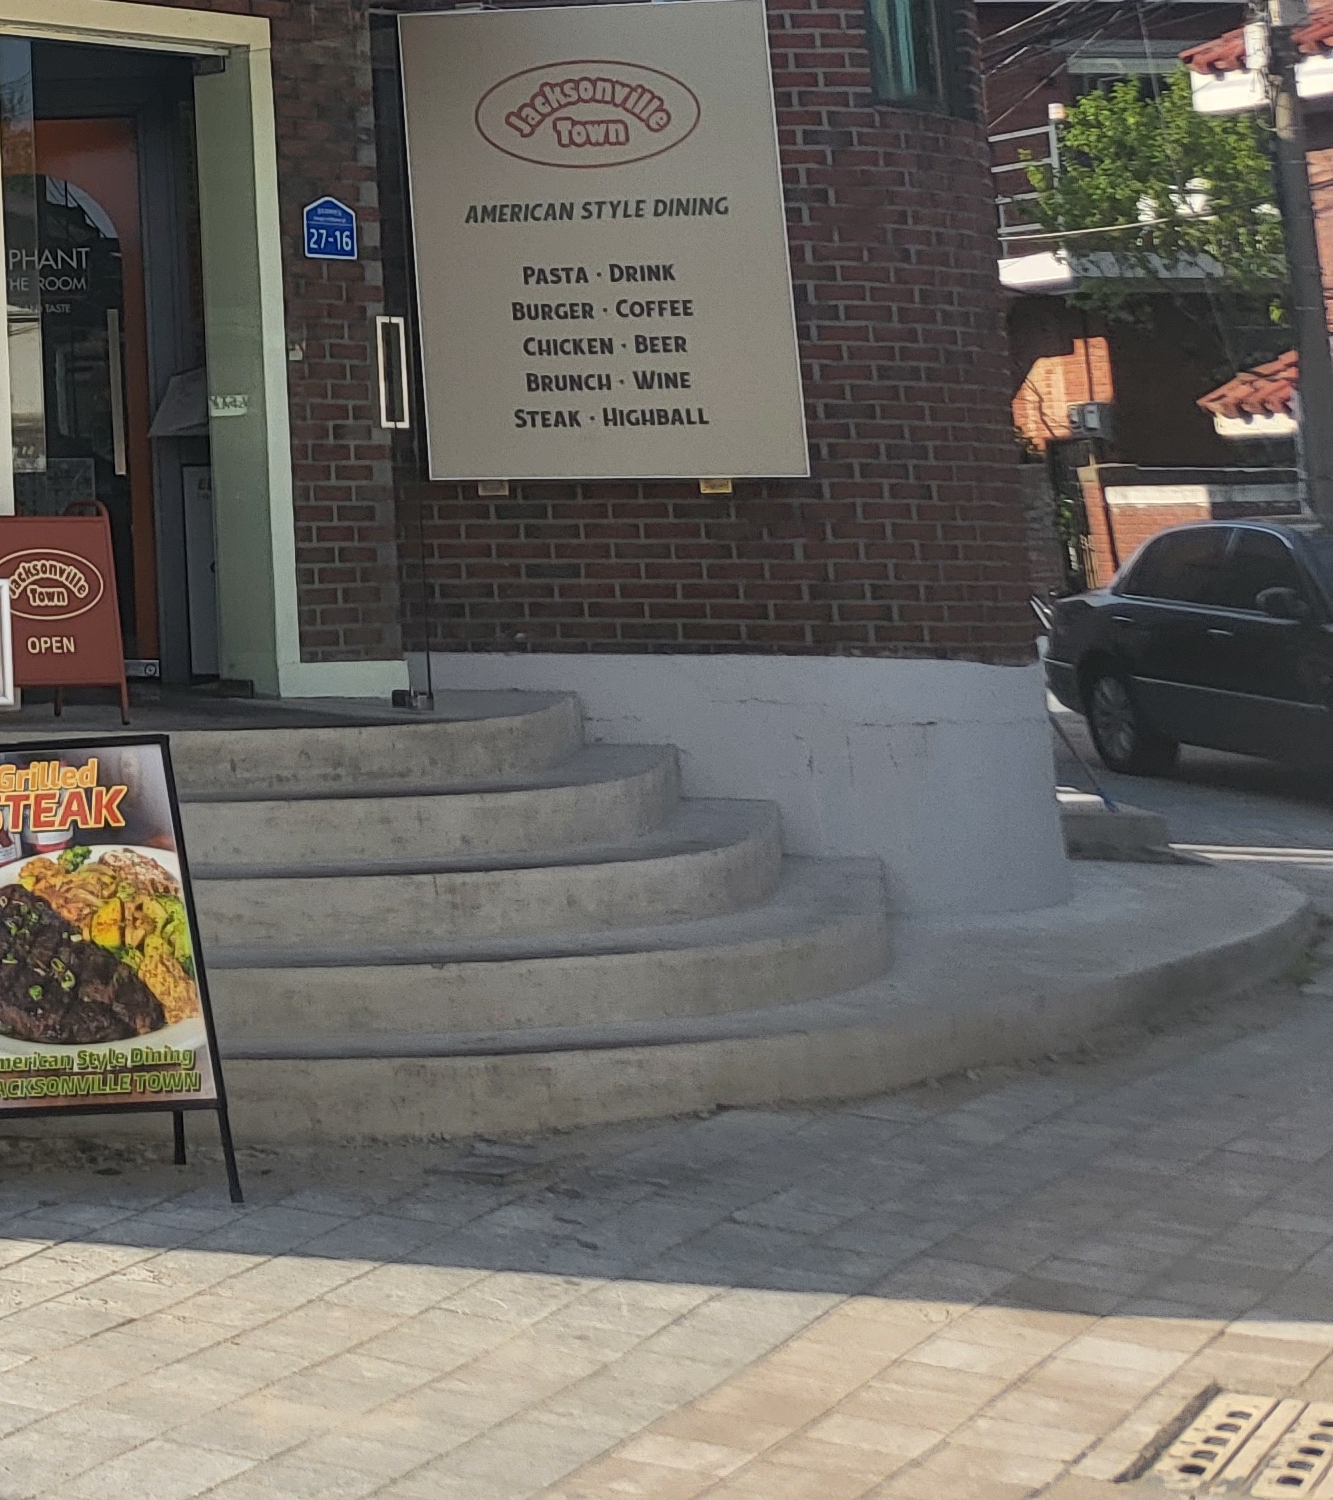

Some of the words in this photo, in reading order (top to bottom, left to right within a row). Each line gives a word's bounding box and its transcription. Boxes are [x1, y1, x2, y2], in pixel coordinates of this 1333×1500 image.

[505, 77, 672, 138] Jacksonville
[552, 117, 630, 147] Town
[464, 202, 575, 225] AMERICAN
[580, 199, 646, 220] STYLE
[653, 196, 730, 217] DINING
[309, 228, 352, 251] 27-16
[8, 276, 30, 291] HE
[39, 275, 87, 291] ROOM
[522, 266, 589, 286] PASTA
[608, 263, 676, 283] DRINK
[45, 303, 72, 313] TASTE
[511, 302, 595, 321] BURGER
[615, 299, 694, 319] COFFEE
[523, 336, 614, 357] CHICKEN
[634, 334, 687, 354] BEER
[525, 372, 612, 392] BRUNCH
[633, 370, 691, 390] WINE
[513, 409, 582, 429] STEAK
[602, 407, 710, 428] HIGHBALL
[27, 584, 68, 606] Town
[27, 636, 75, 654] OPEN
[76, 1048, 128, 1073] Style
[130, 1045, 196, 1068] Dining
[135, 1070, 202, 1093] TOWN
